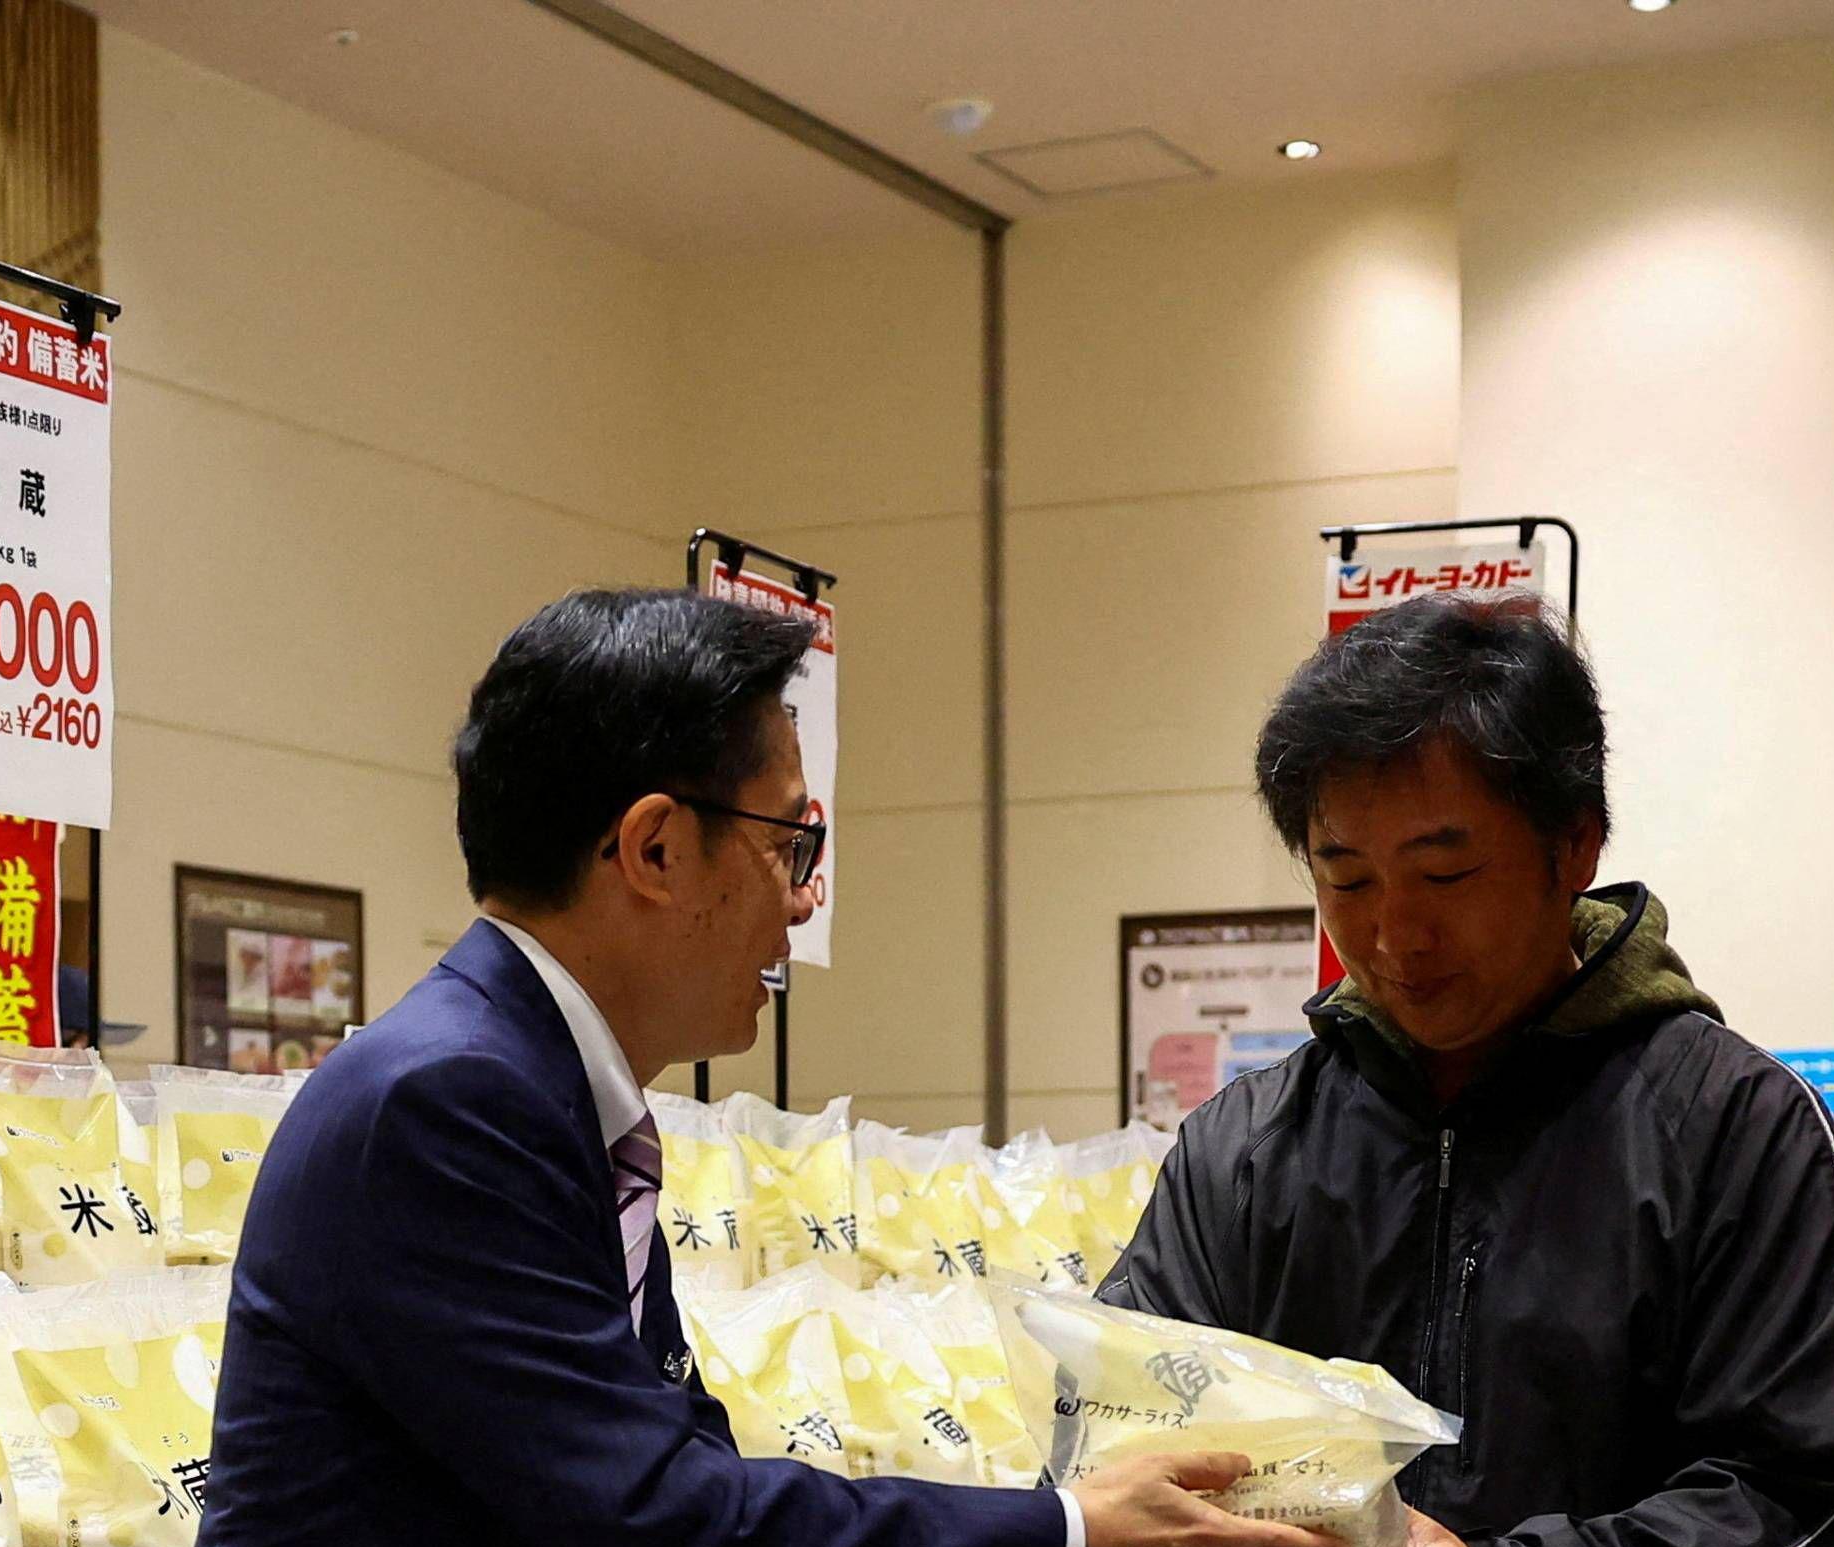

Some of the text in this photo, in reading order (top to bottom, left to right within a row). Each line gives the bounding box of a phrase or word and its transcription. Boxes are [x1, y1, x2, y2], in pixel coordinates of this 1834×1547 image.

[27, 327, 105, 391] 備蓄米
[1375, 559, 1532, 596] イトーヨーカドー
[1084, 1401, 1187, 1430] ワカサーライス
